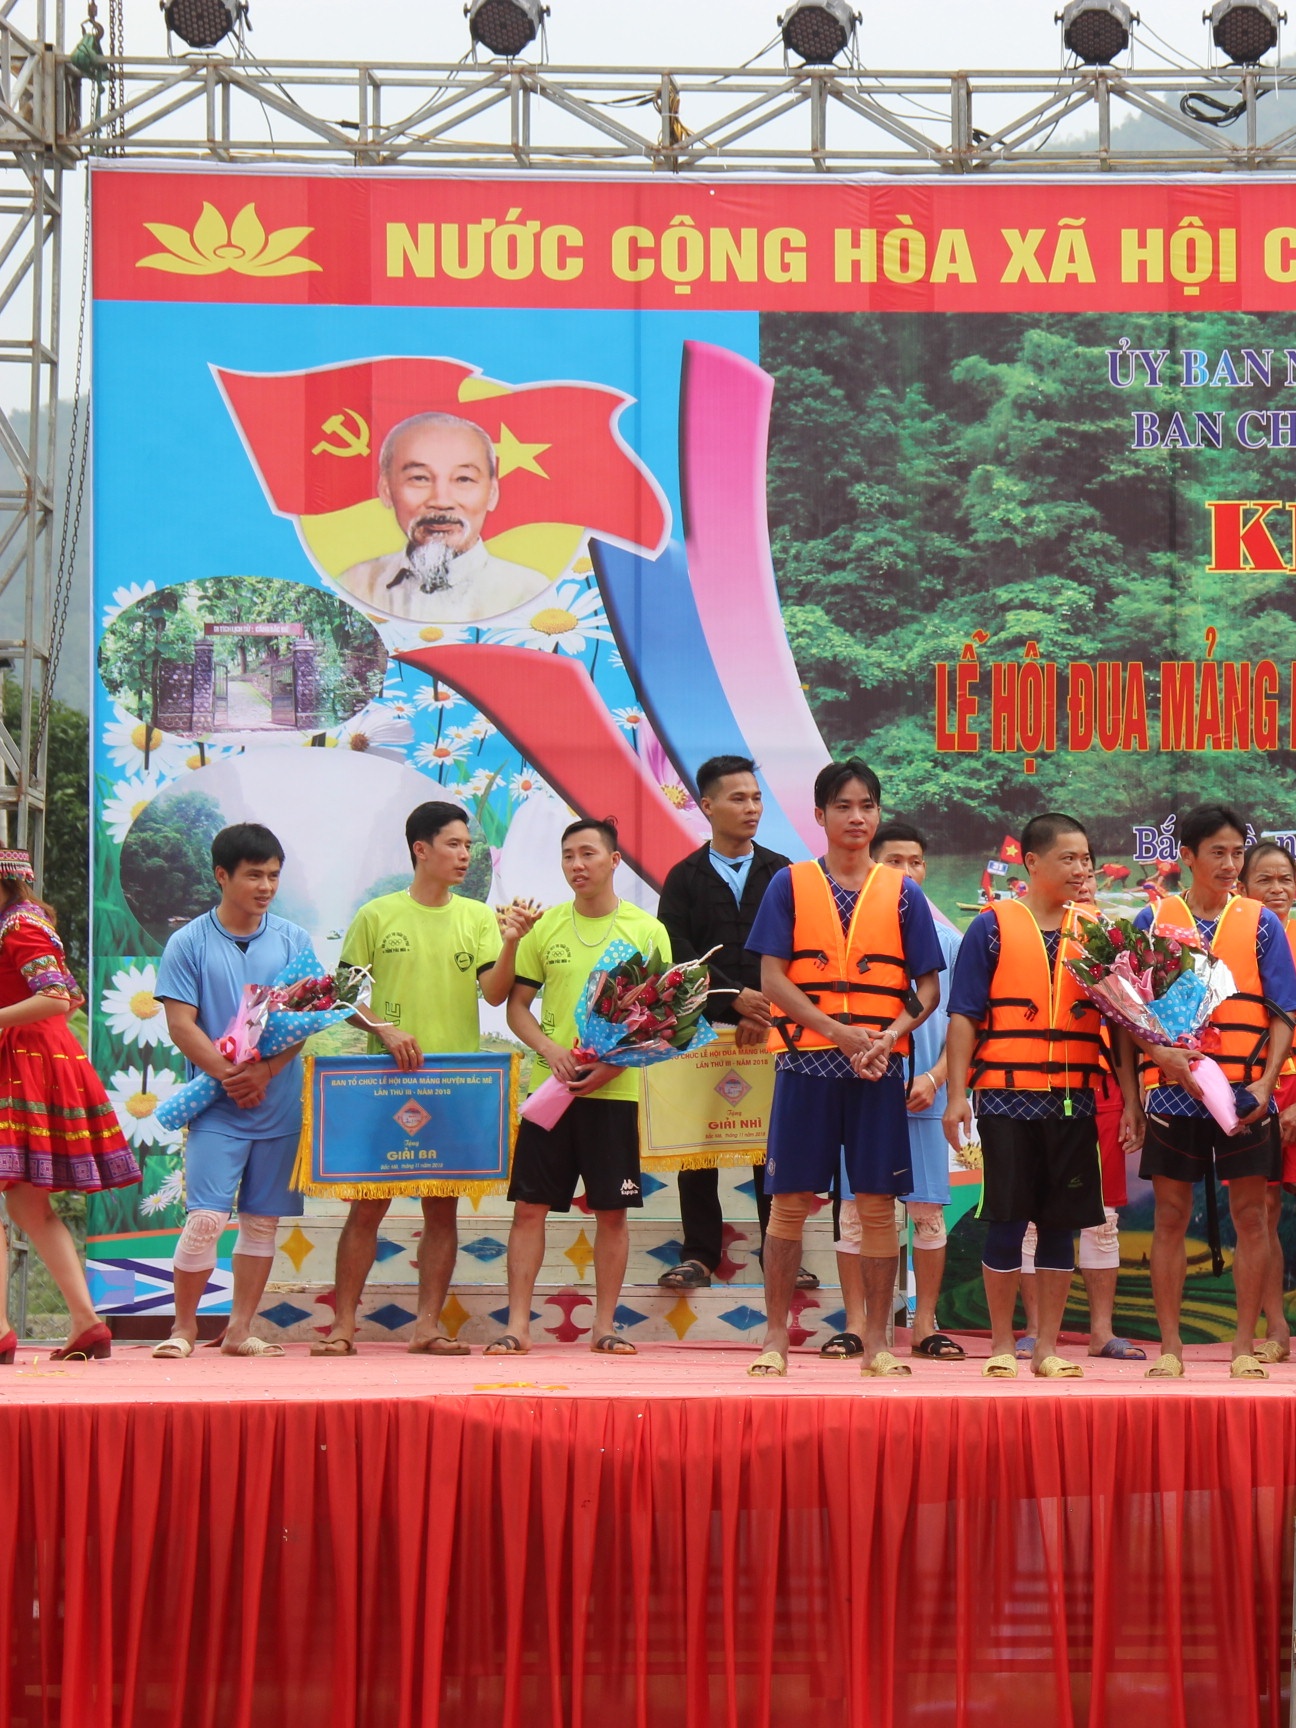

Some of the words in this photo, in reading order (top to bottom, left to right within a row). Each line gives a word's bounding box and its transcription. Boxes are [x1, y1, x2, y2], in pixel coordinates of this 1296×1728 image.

[386, 207, 584, 281] NƯỚC
[611, 215, 806, 295] CỘNG
[834, 214, 976, 284] HÒA
[1000, 217, 1097, 283] XÃ
[1120, 216, 1237, 296] HỘI
[1107, 336, 1171, 388] ỦY
[1180, 347, 1274, 388] BAN
[1131, 410, 1225, 450] BAN
[935, 629, 980, 753] LỄ
[991, 640, 1057, 774] HỘI
[1067, 660, 1149, 752] ĐUA
[1160, 626, 1279, 752] MẢNG
[1133, 814, 1181, 862] Bắ
[708, 1117, 736, 1130] GIẢI
[740, 1117, 762, 1129] NHÌ
[386, 1147, 415, 1161] GIẢI
[418, 1149, 437, 1159] BA
